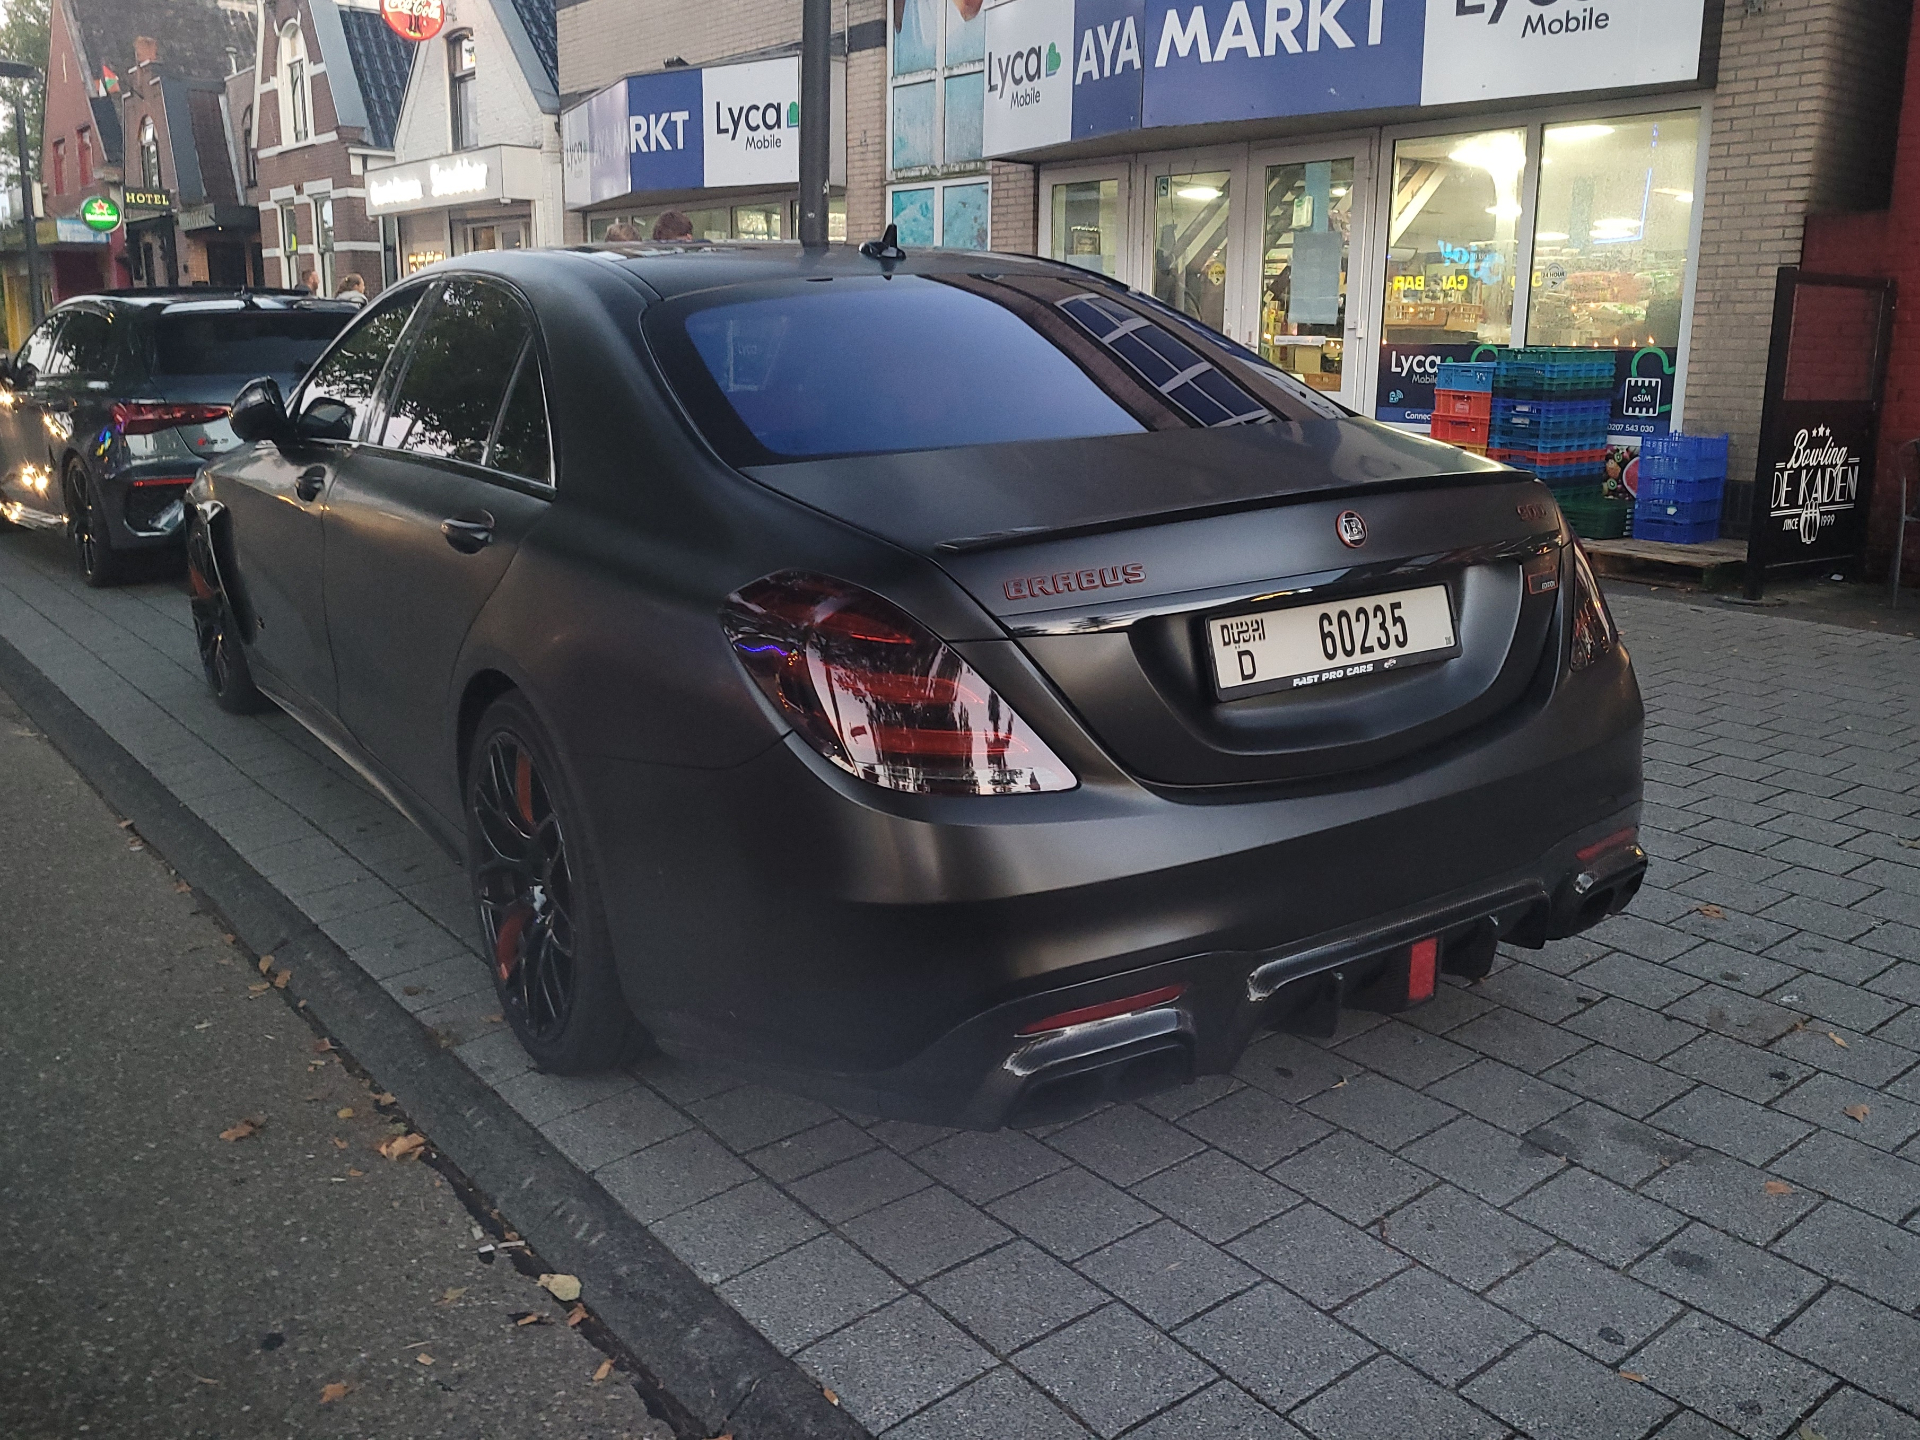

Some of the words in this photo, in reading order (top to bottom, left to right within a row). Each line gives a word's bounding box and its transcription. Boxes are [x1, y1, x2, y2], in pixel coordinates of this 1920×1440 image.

[1521, 7, 1610, 39] Mobile
[1074, 16, 1141, 86] AYA
[1154, 0, 1384, 67] MARKT
[987, 46, 1042, 100] Lyca
[1010, 88, 1041, 110] Mobile
[716, 101, 782, 141] Lyca
[745, 134, 782, 151] Mobile
[126, 192, 169, 206] HOTEL
[1391, 351, 1441, 376] Lyca
[1411, 374, 1438, 383] Mobile
[1632, 394, 1651, 402] eSIM
[1625, 424, 1639, 432] 543
[1640, 425, 1654, 433] 030
[1787, 429, 1848, 476] Bowling
[1771, 470, 1794, 508] DE
[1798, 465, 1859, 505] KADEN
[1821, 514, 1835, 527] 1999
[1004, 563, 1147, 600] BRABUS
[1318, 601, 1409, 661] 60235
[1237, 649, 1257, 681] D
[1293, 675, 1319, 687] FAST
[1321, 668, 1344, 681] PRO
[1347, 663, 1374, 675] CARS
